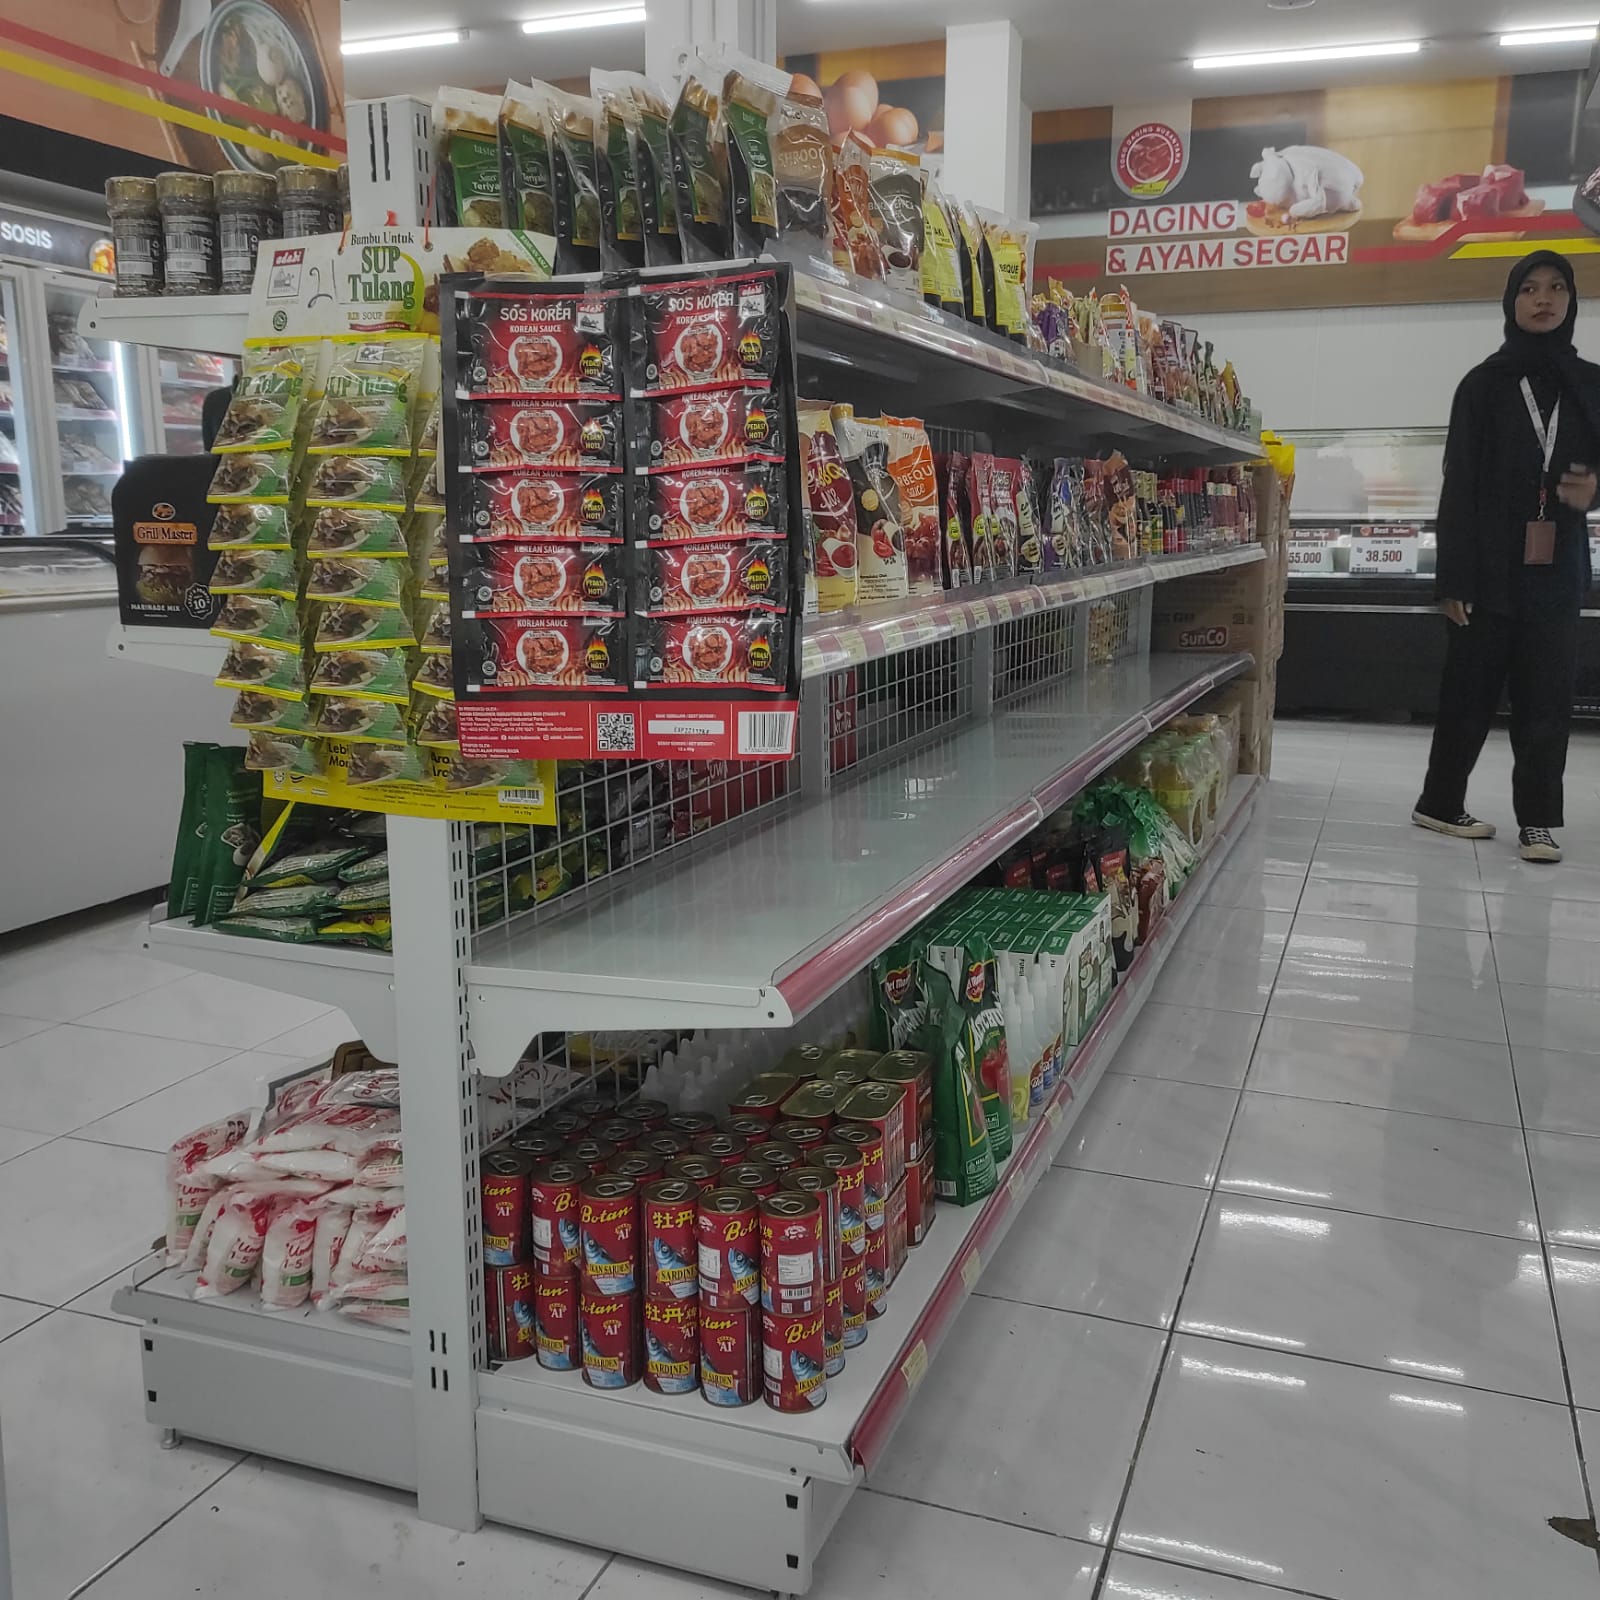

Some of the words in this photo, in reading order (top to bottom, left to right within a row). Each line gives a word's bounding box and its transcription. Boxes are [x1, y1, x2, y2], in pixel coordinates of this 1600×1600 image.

[1110, 203, 1236, 236] DAGING
[1, 221, 53, 249] SOSIS
[351, 232, 381, 246] Bumbu
[383, 231, 415, 244] Untuk
[361, 245, 400, 274] SUP
[1108, 248, 1126, 274] &
[1135, 241, 1224, 271] AYAM
[1233, 235, 1346, 265] SEGAR
[348, 274, 416, 310] Tulang
[362, 311, 382, 320] SOUP
[509, 324, 537, 334] KOREAN
[539, 324, 562, 334] SAUCE
[137, 526, 159, 539] Grill
[161, 527, 194, 540] Master
[1288, 552, 1322, 563] 55.000
[1365, 550, 1402, 562] 38.500
[193, 598, 206, 610] 10
[517, 618, 545, 628] KOREAN
[546, 618, 569, 628] SAUCE
[581, 1204, 633, 1223] Botan
